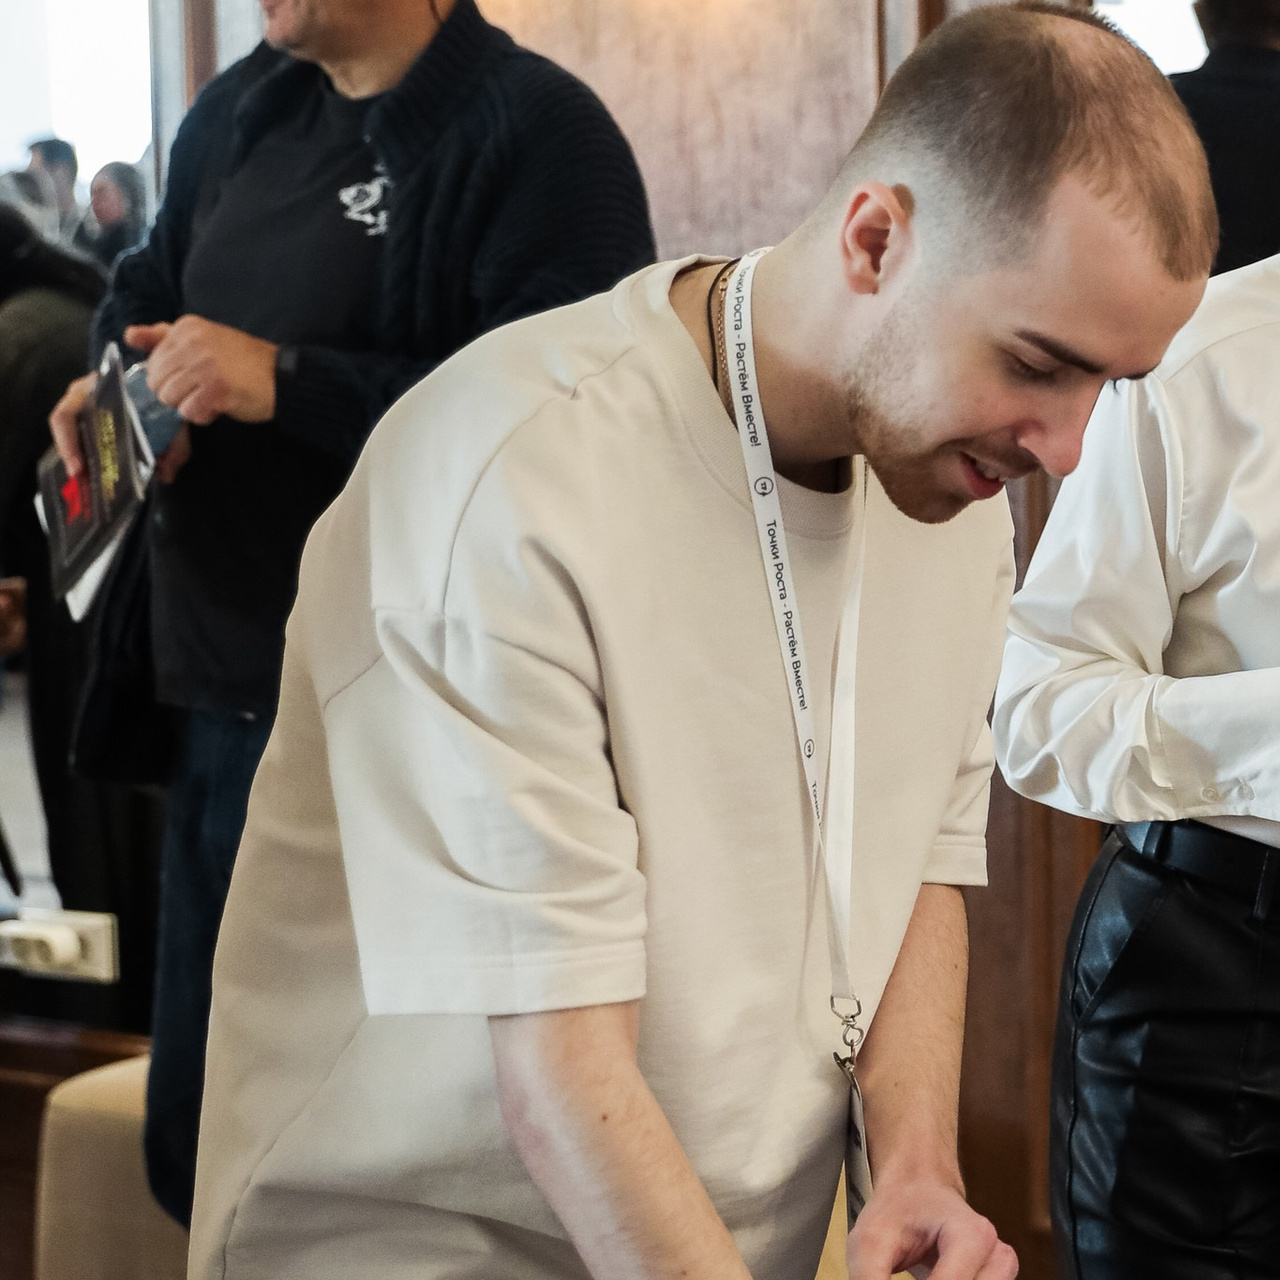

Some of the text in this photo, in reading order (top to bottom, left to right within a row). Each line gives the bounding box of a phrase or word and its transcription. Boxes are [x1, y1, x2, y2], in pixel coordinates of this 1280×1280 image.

[734, 265, 751, 295] Точки
[733, 295, 744, 331] Роста
[735, 342, 750, 392] Растём
[742, 394, 762, 448] Вместе!
[766, 519, 778, 561] Точки
[773, 563, 787, 601] Роста
[783, 610, 798, 658] Растём
[792, 660, 808, 711] Вместе!
[811, 781, 821, 820] Точки
